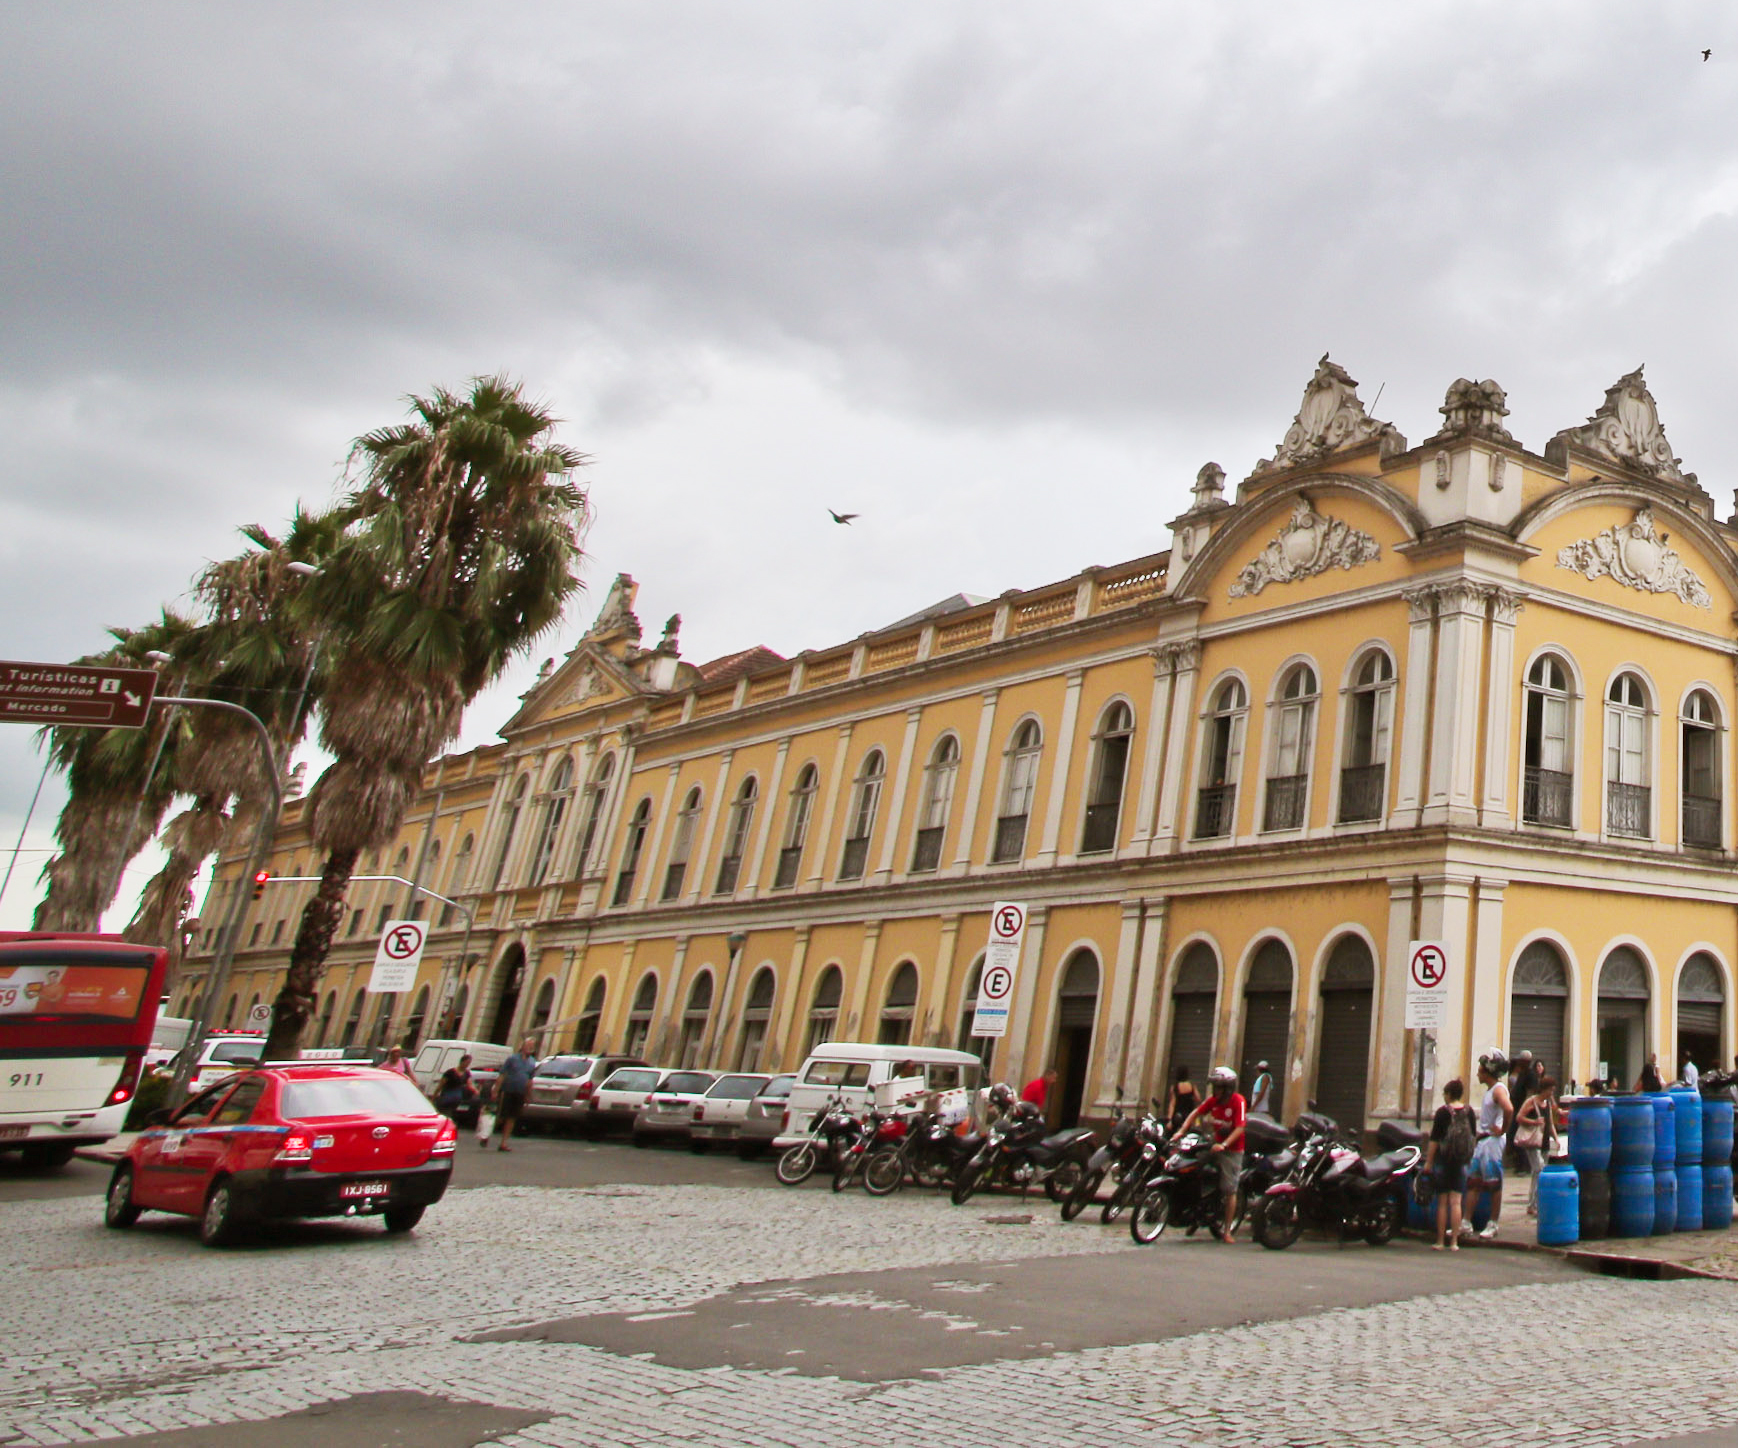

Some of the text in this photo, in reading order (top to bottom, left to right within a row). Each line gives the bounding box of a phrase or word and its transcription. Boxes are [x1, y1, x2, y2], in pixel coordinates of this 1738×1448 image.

[16, 684, 94, 696] Information
[7, 702, 67, 712] Mercado
[991, 973, 1004, 992] E
[9, 1073, 44, 1087] 911
